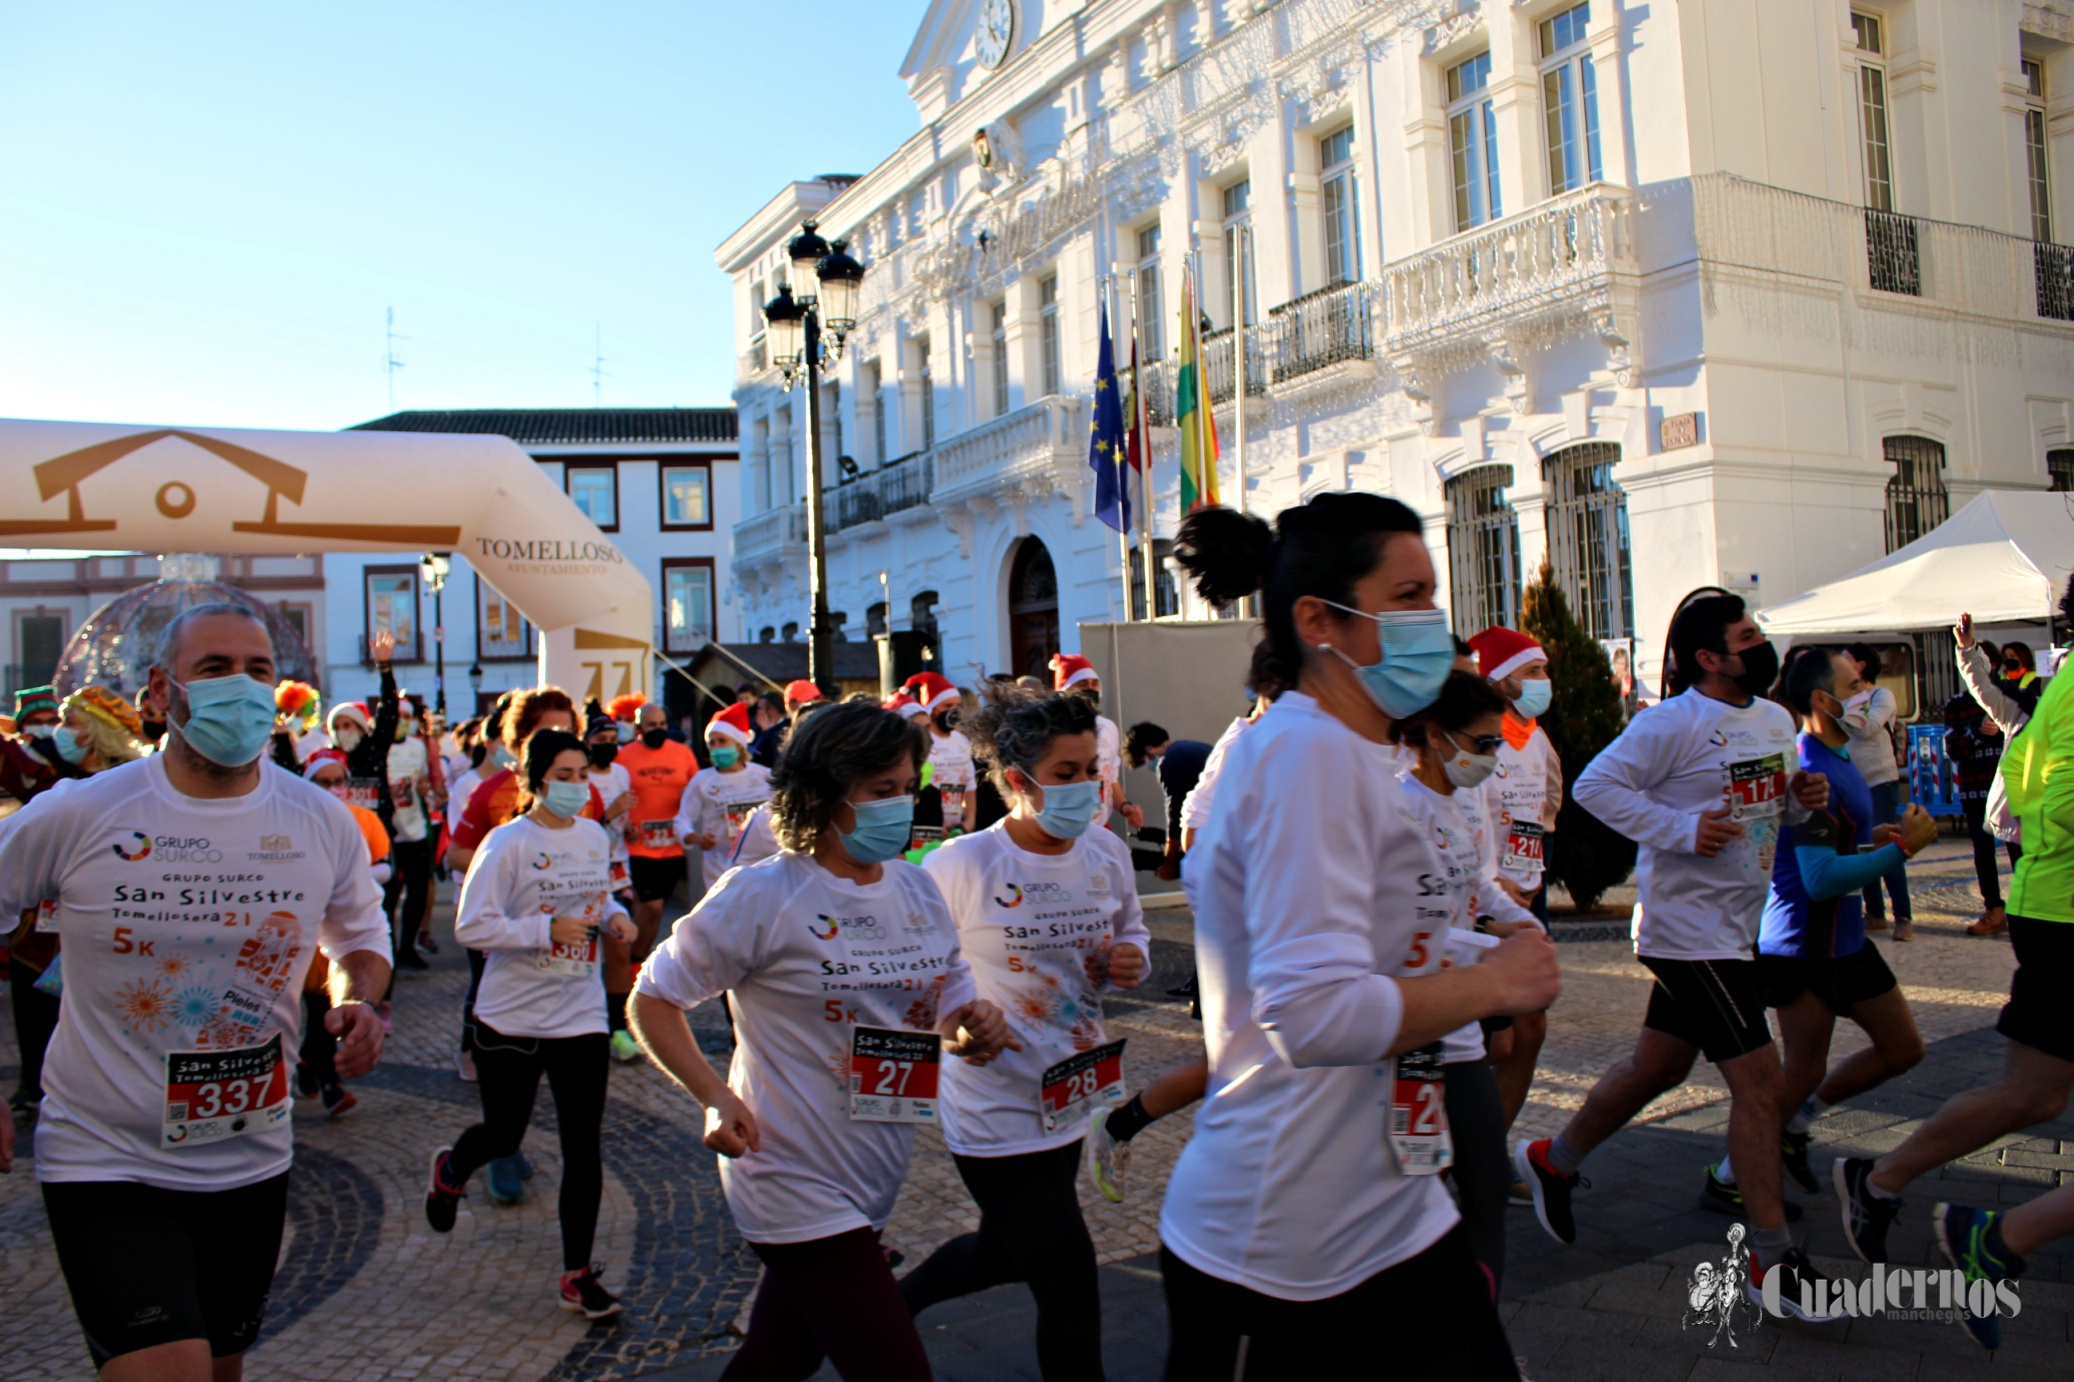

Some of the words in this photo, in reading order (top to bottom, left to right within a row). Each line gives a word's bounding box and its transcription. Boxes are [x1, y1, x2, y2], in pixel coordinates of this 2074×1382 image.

[476, 537, 624, 563] TOMELLOSO
[155, 835, 210, 850] GRUPO
[154, 849, 223, 864] SURCO
[162, 874, 211, 883] GRUPO
[217, 874, 265, 884] SURCO
[114, 885, 165, 903] San
[179, 888, 305, 906] Silvestre
[112, 908, 220, 922] Tomellosera
[223, 911, 251, 927] 21
[841, 927, 886, 940] URCO
[1004, 925, 1041, 939] San
[821, 960, 861, 976] San
[821, 980, 902, 992] Tomellosera
[903, 979, 922, 992] 21
[222, 989, 262, 1013] Pieles
[857, 1035, 881, 1046] San
[177, 1060, 212, 1074] San
[875, 1059, 914, 1096] 27
[1065, 1067, 1098, 1105] 28
[195, 1072, 275, 1118] 337
[1412, 1083, 1440, 1134] 2
